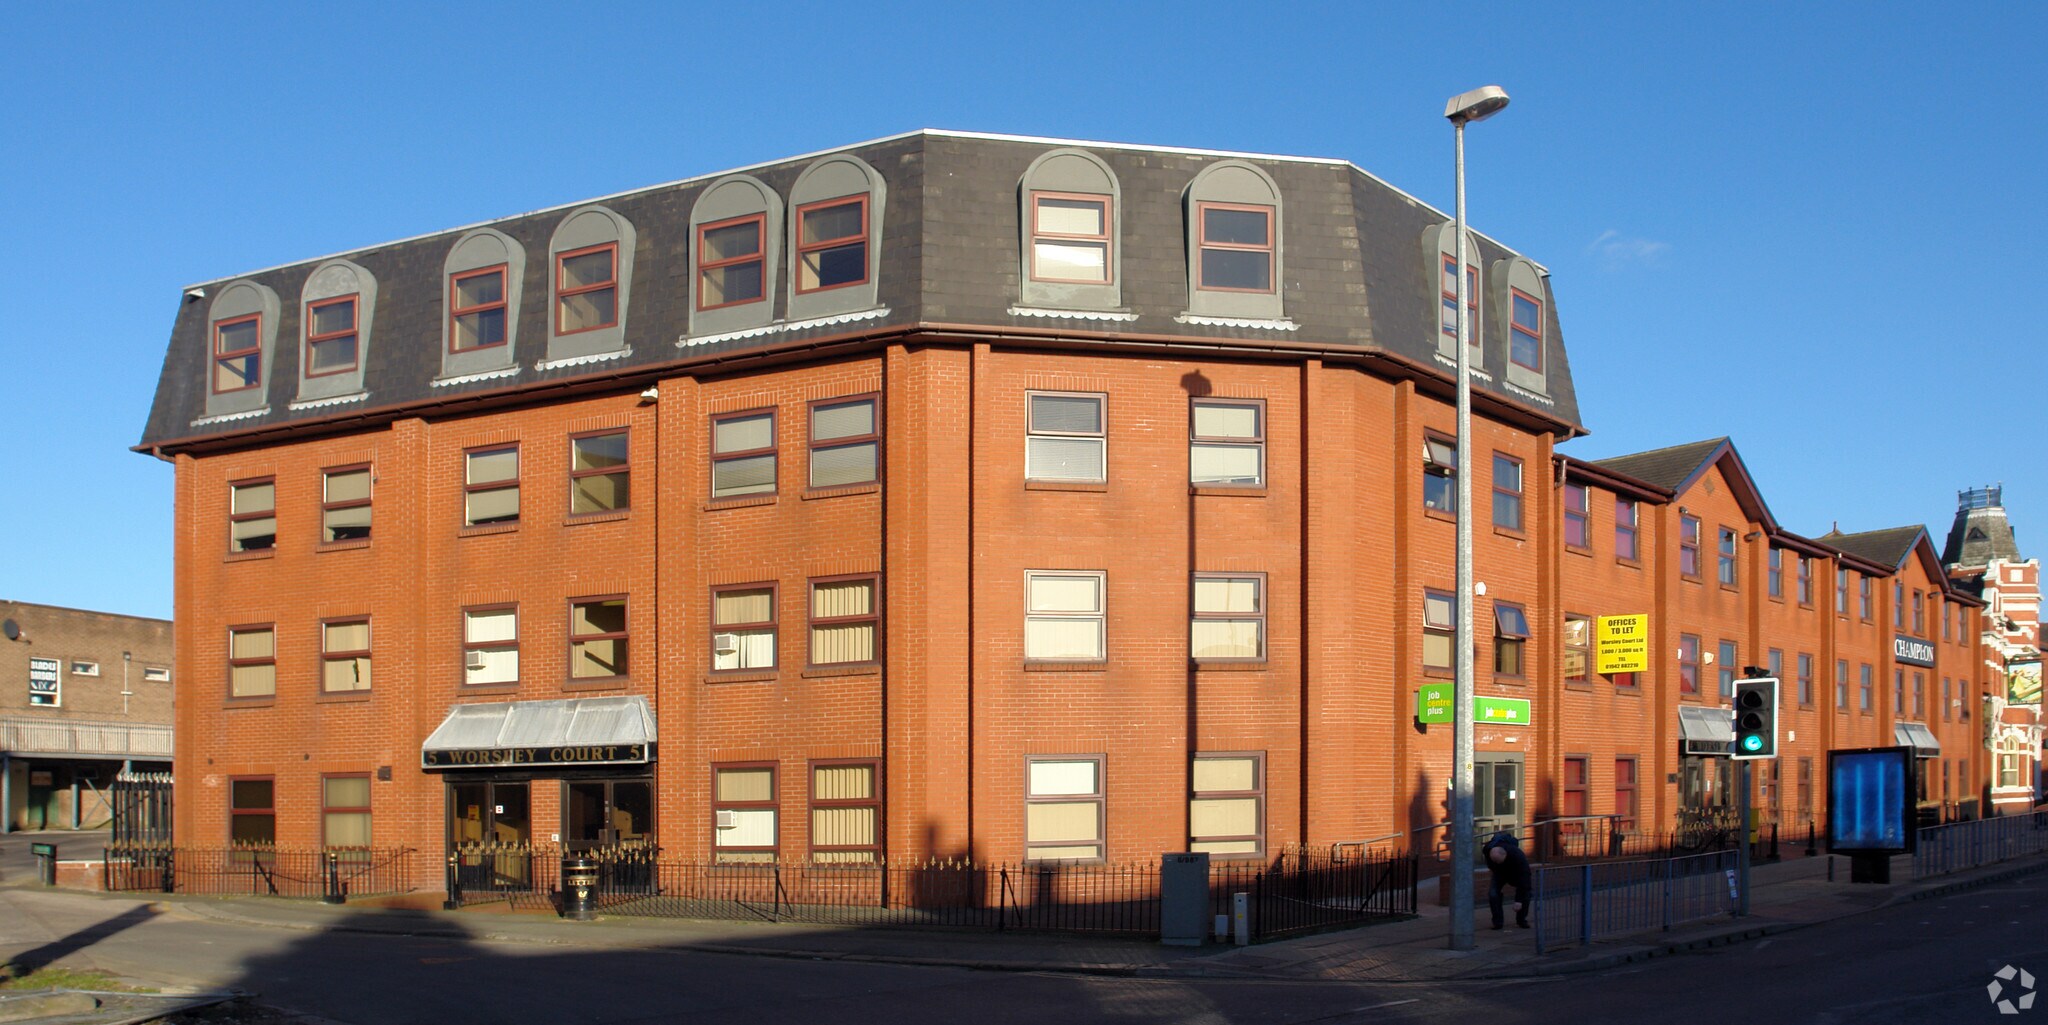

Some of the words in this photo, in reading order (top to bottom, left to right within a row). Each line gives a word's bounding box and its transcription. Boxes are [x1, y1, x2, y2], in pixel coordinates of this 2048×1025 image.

[1608, 618, 1637, 626] OFFICES
[1894, 639, 1934, 661] CHAMPION
[30, 660, 56, 671] BLADES
[30, 670, 56, 681] BARBERS
[1427, 691, 1440, 700] job
[1427, 706, 1444, 717] plus
[428, 750, 438, 765] 5
[449, 748, 537, 764] WORSLEY
[550, 746, 617, 762] COURT
[630, 744, 641, 761] 5
